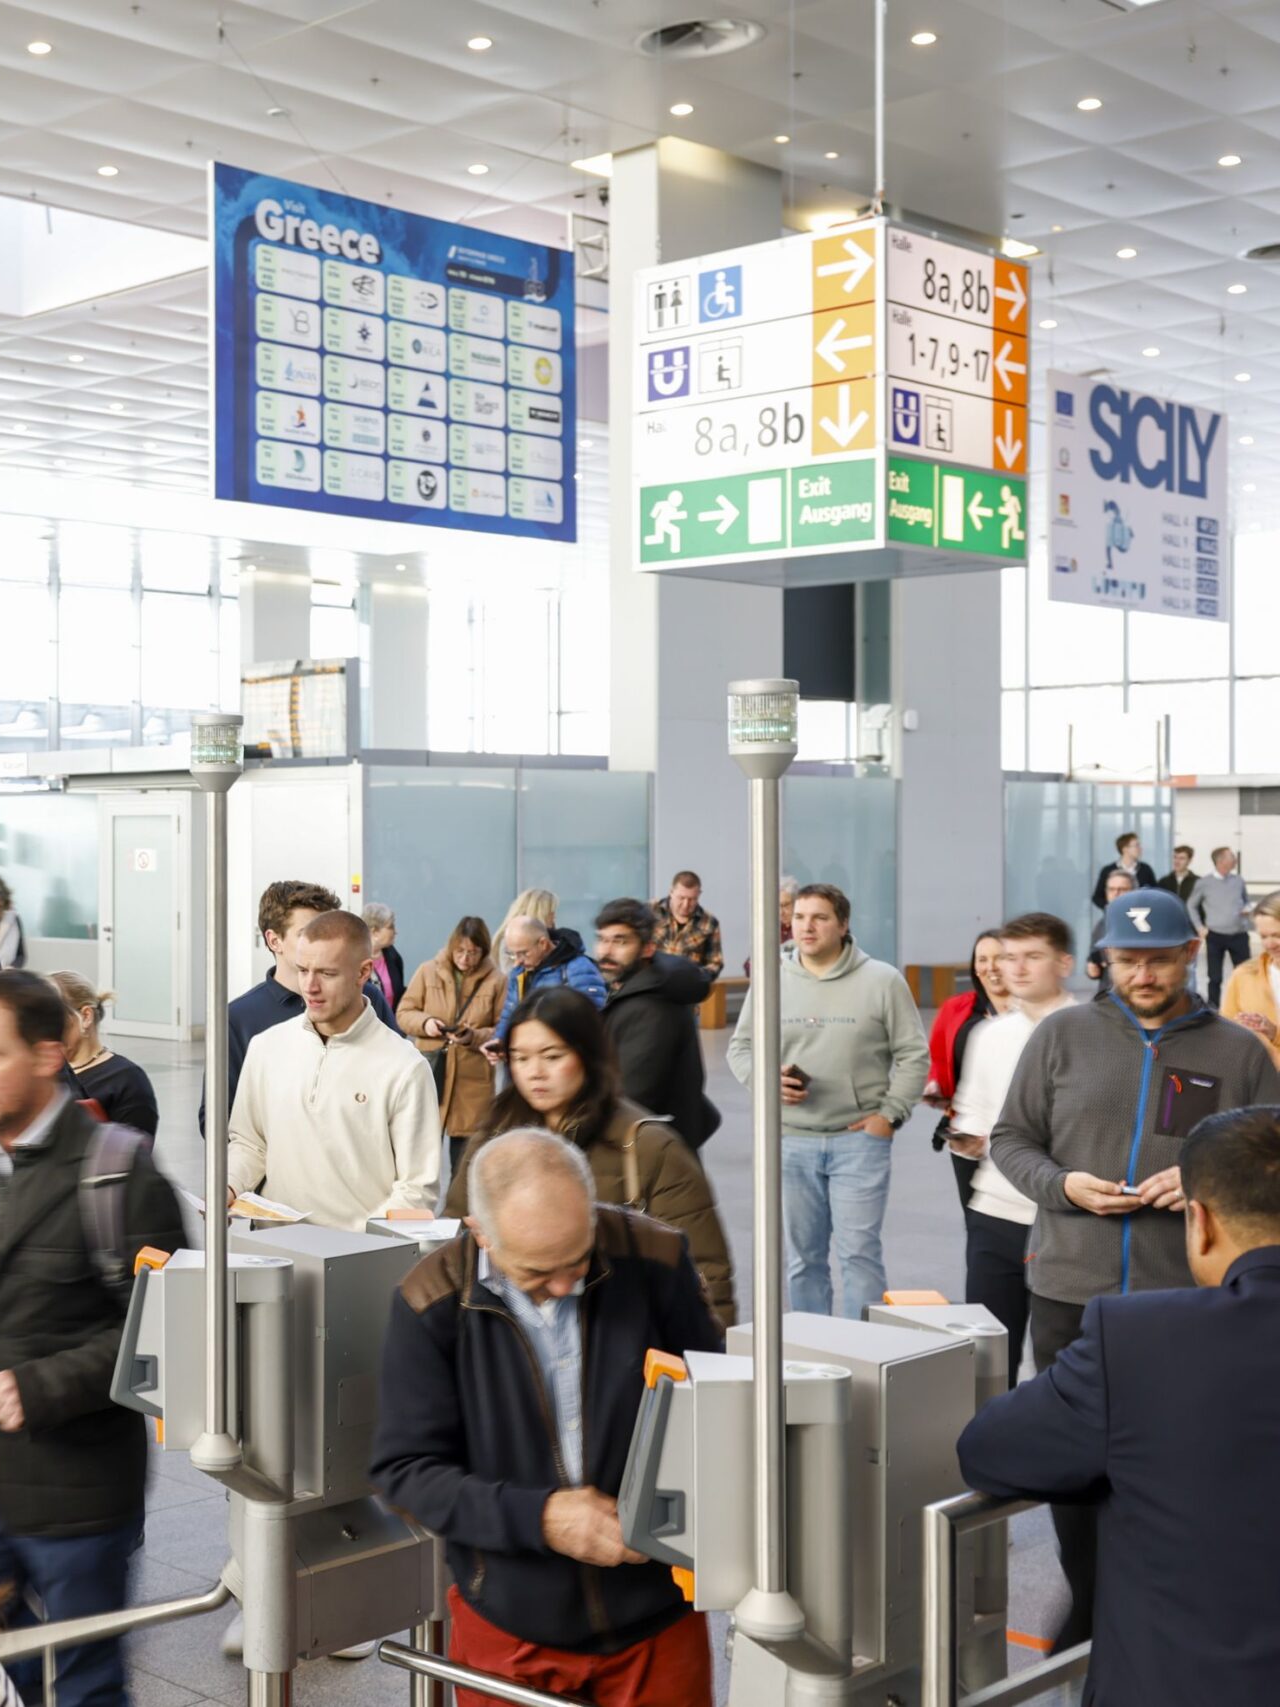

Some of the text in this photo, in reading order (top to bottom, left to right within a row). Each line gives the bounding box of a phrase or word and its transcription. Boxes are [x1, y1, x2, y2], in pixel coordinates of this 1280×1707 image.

[255, 198, 381, 264] Greece
[892, 234, 912, 253] Halle
[892, 309, 912, 327] Halle
[1089, 384, 1221, 499] SICILY
[798, 475, 831, 498] Exit
[888, 470, 910, 493] Exit
[800, 500, 872, 526] Ausgang
[889, 499, 933, 528] Ausgang
